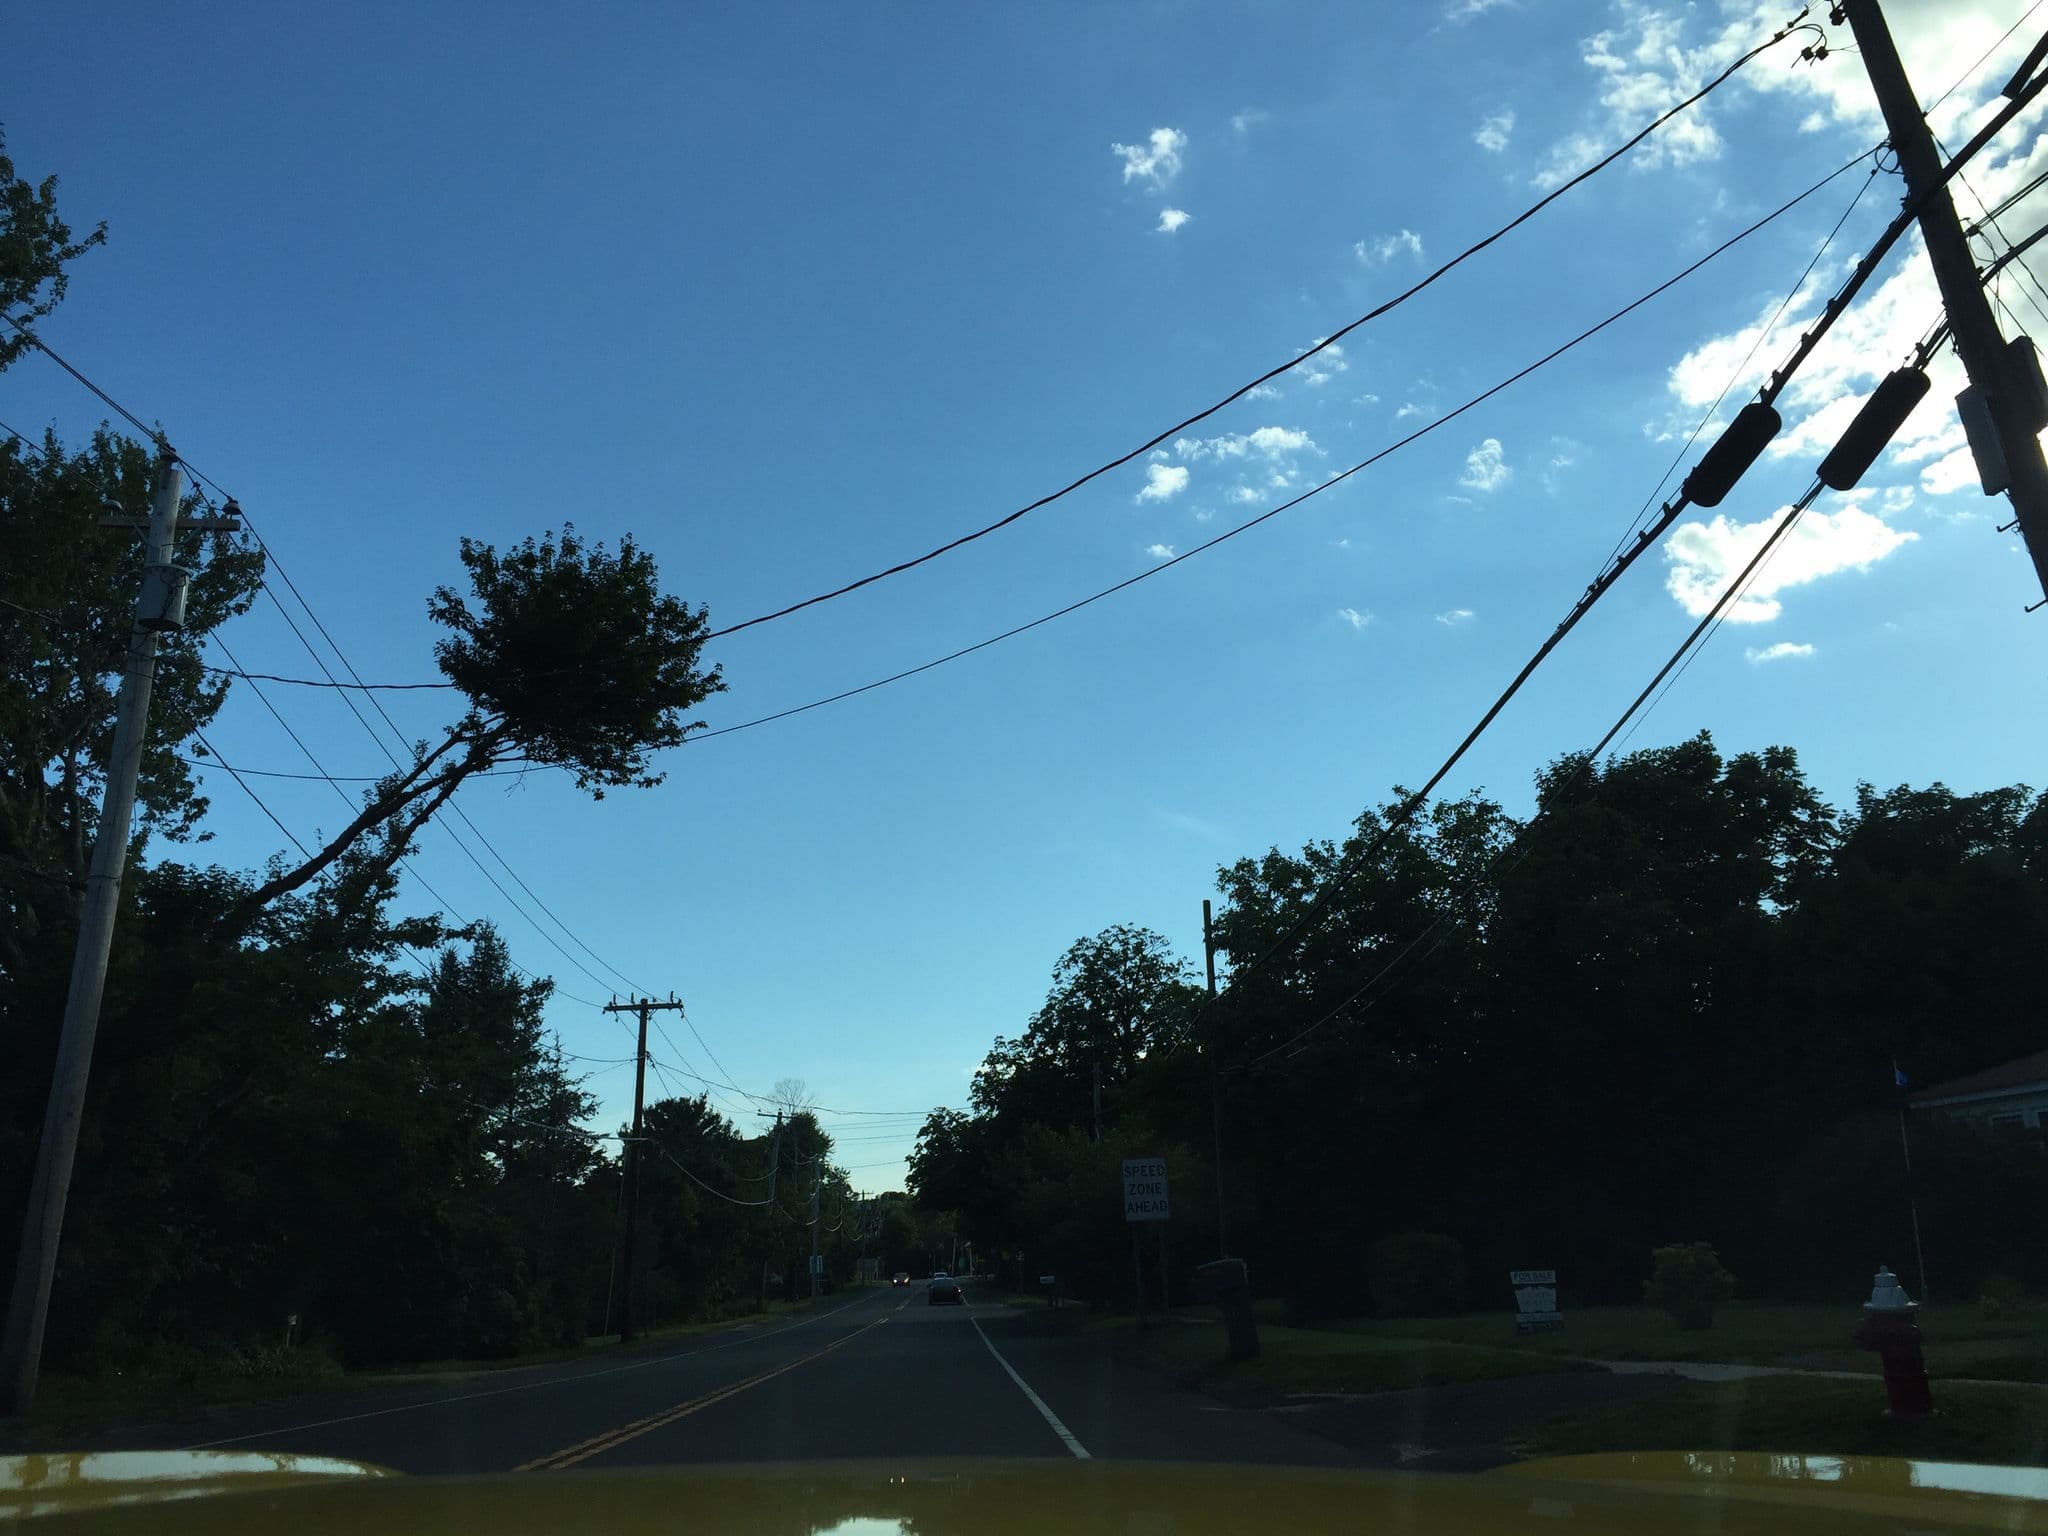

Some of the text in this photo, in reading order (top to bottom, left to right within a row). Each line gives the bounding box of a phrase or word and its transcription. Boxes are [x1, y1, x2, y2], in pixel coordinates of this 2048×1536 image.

[1124, 1165, 1165, 1177] SPEED
[1129, 1183, 1162, 1195] ZONE
[1127, 1200, 1168, 1213] AHEAD
